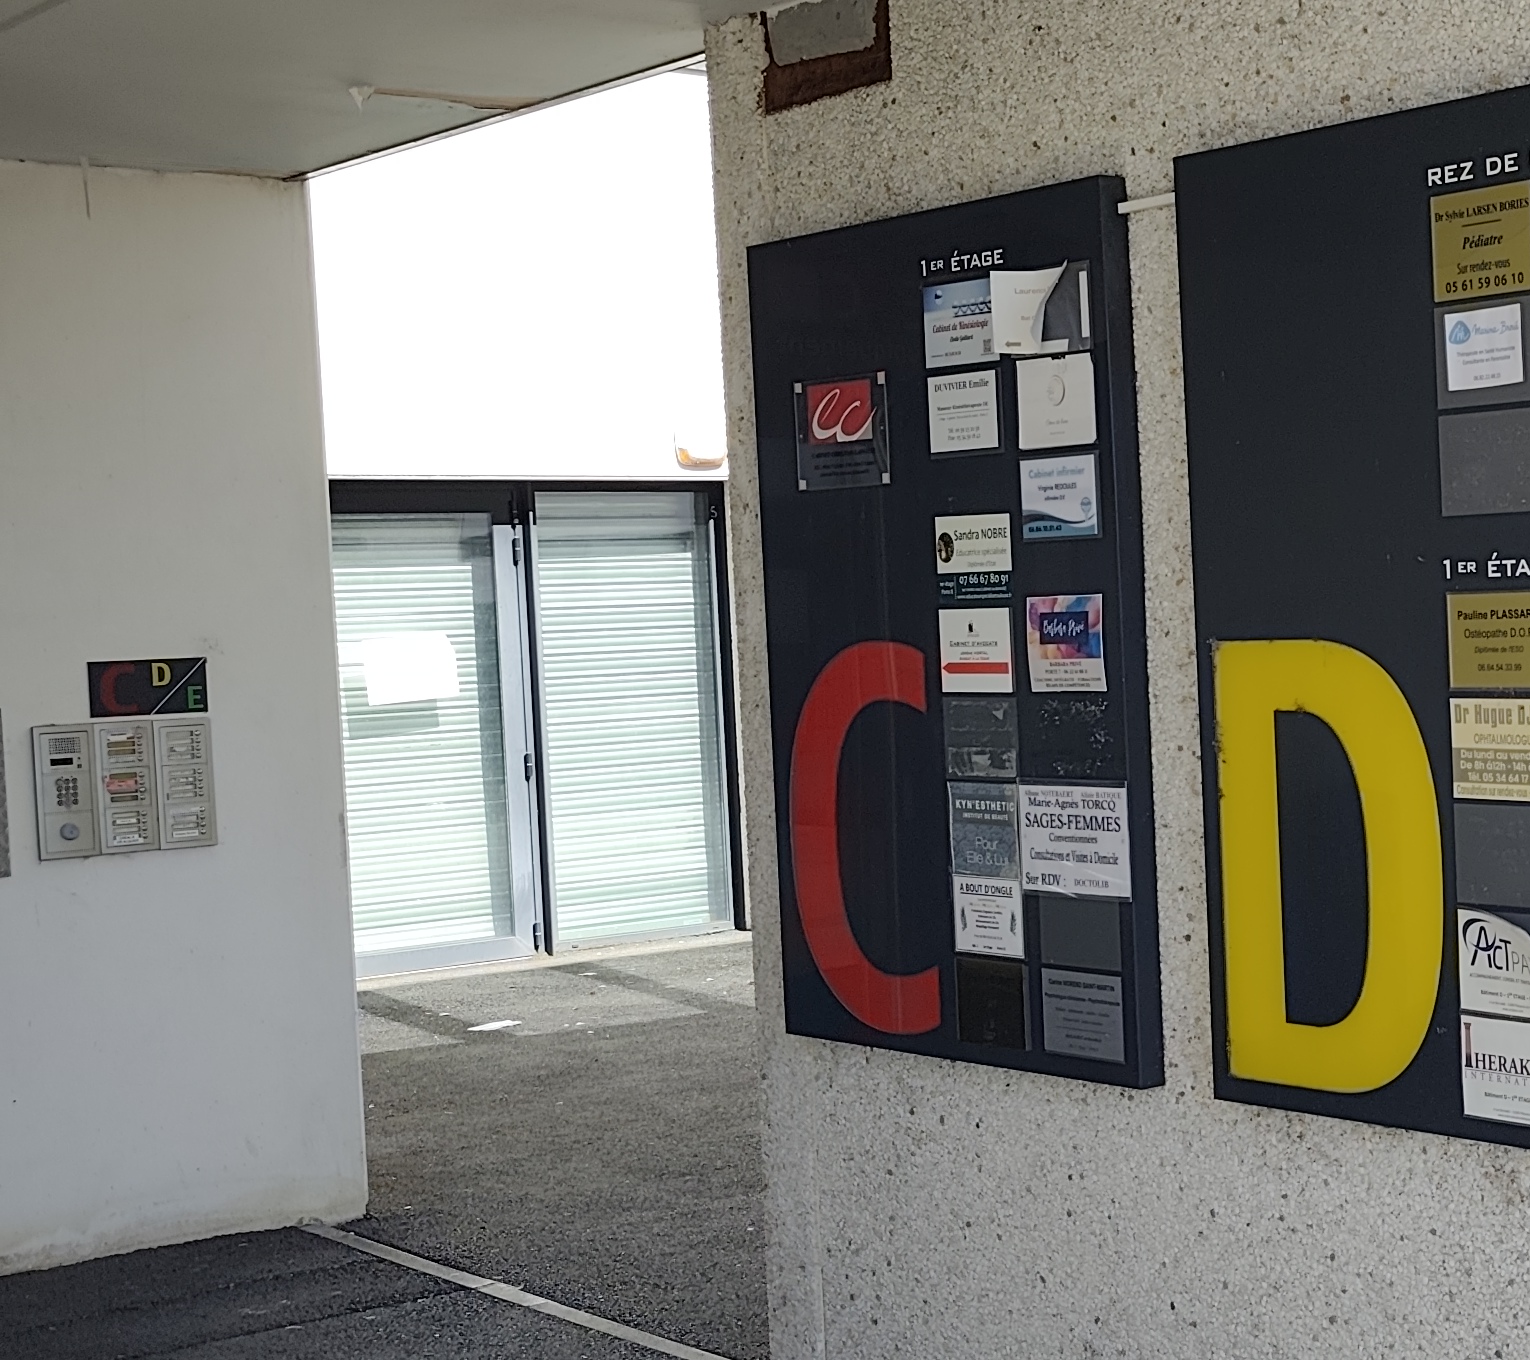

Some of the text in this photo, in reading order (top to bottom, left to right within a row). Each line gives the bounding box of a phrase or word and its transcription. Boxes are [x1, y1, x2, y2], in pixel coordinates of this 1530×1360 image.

[1428, 161, 1474, 186] REZ
[1486, 153, 1518, 176] DE
[1434, 212, 1444, 222] Dr
[1466, 202, 1498, 218] LARSEN
[1500, 197, 1529, 212] BORIES
[1462, 234, 1503, 250] Pédiatre
[951, 249, 1003, 271] ÉTAGE
[1446, 272, 1524, 293] 05 61 59 06 10
[954, 527, 1007, 541] Sandra NOBRE
[959, 576, 967, 585] 07
[969, 574, 978, 584] 66
[980, 574, 988, 585] 67
[1458, 611, 1488, 620] Pauline
[101, 663, 171, 713] C D
[188, 686, 204, 709] E
[1455, 704, 1469, 724] Dr
[1475, 705, 1512, 728] Hugue
[1028, 797, 1116, 812] Marie-Agnès TORCQ
[1025, 812, 1121, 832] SAGES-FEMMES
[790, 641, 942, 1035] C
[1210, 639, 1444, 1094] D
[960, 883, 1013, 895] A BOUT D'ONGLE
[1026, 872, 1061, 886] Sur RDV
